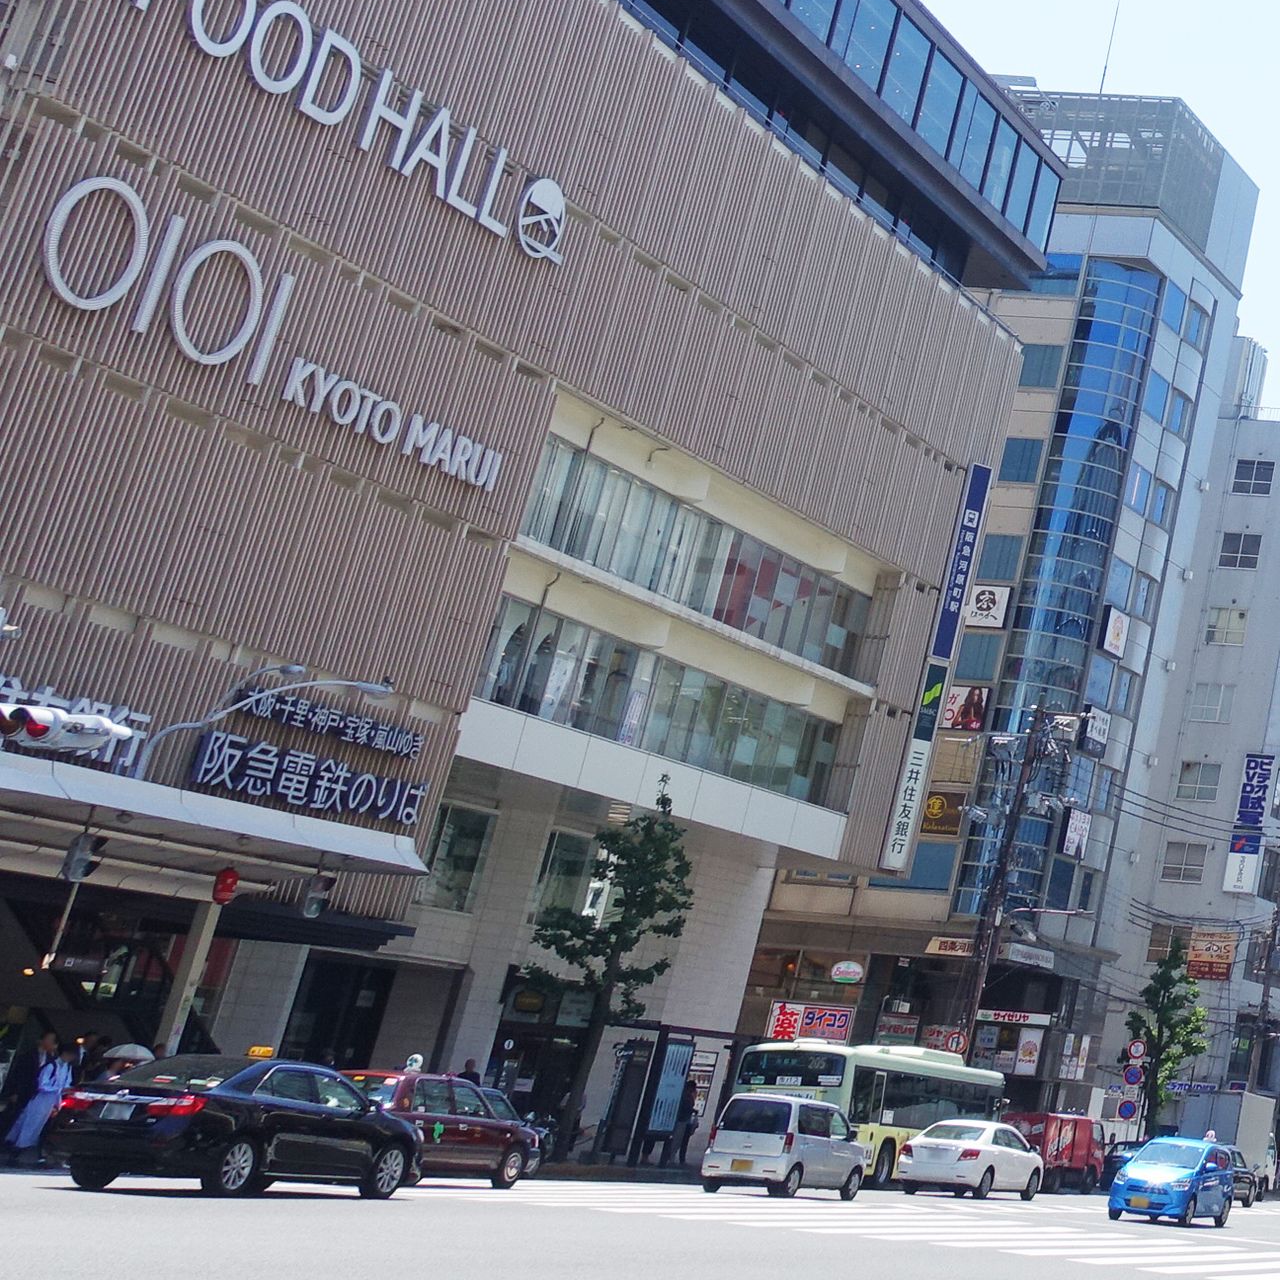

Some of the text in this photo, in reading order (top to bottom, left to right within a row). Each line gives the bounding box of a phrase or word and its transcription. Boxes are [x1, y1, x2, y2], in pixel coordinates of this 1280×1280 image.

[357, 68, 508, 239] HALL
[281, 356, 503, 493] KYOTO MARUI
[197, 730, 431, 826] 阪急電鉄のりば
[890, 750, 926, 855] 三井住友銀行
[993, 1012, 1030, 1023] サイゼリヤ
